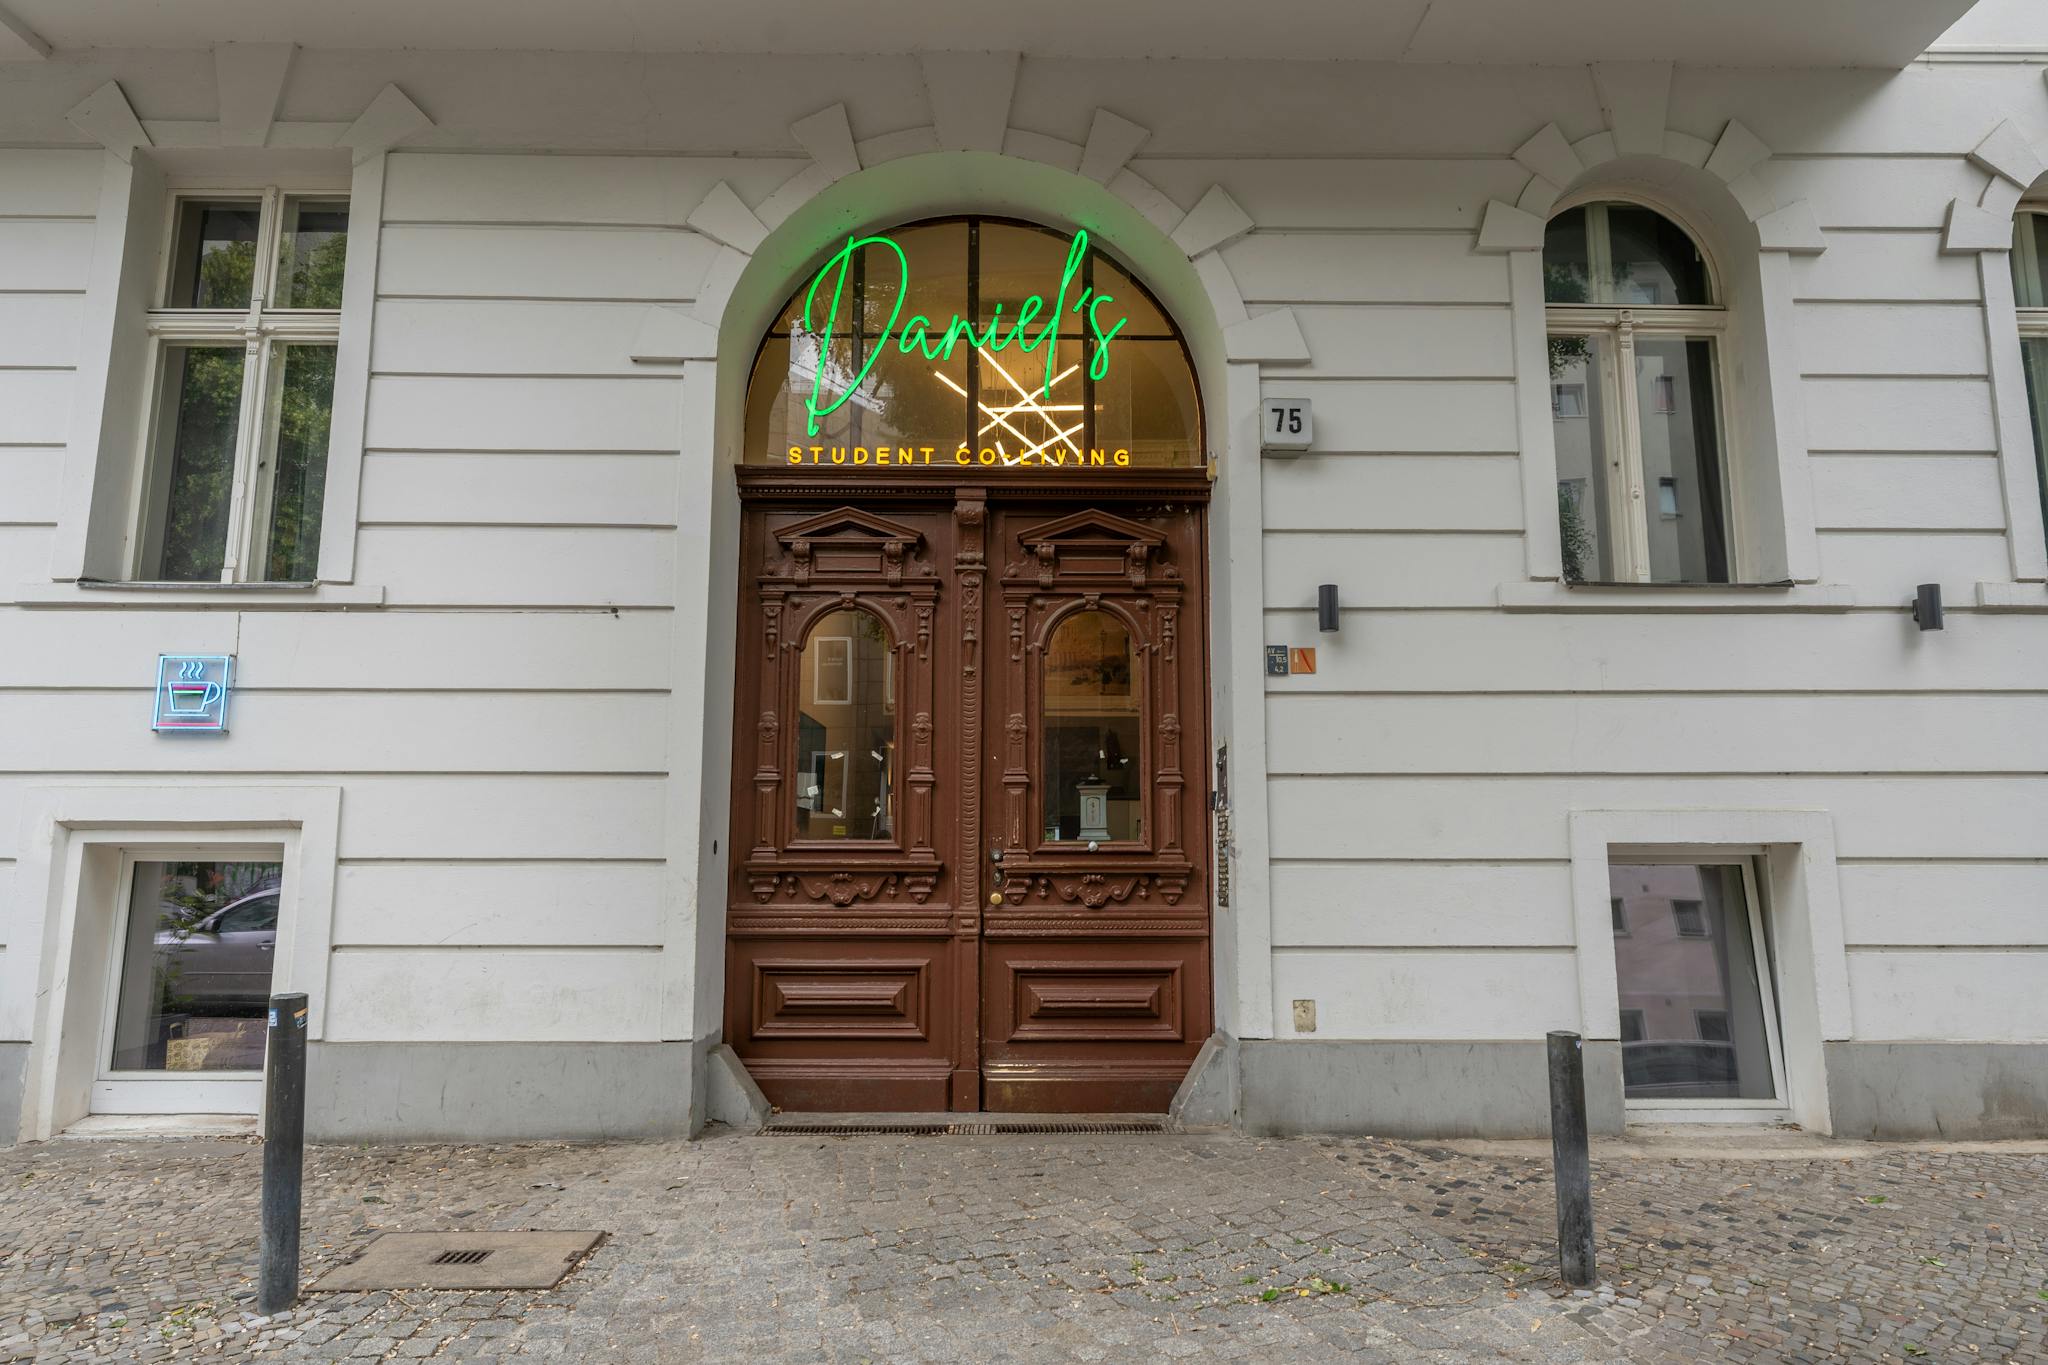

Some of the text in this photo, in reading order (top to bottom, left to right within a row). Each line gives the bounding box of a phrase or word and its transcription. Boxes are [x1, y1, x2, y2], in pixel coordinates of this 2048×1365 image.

[805, 229, 1127, 438] Daniel's
[1271, 408, 1302, 433] 75
[788, 446, 1130, 465] STUDENT CO-LIVING
